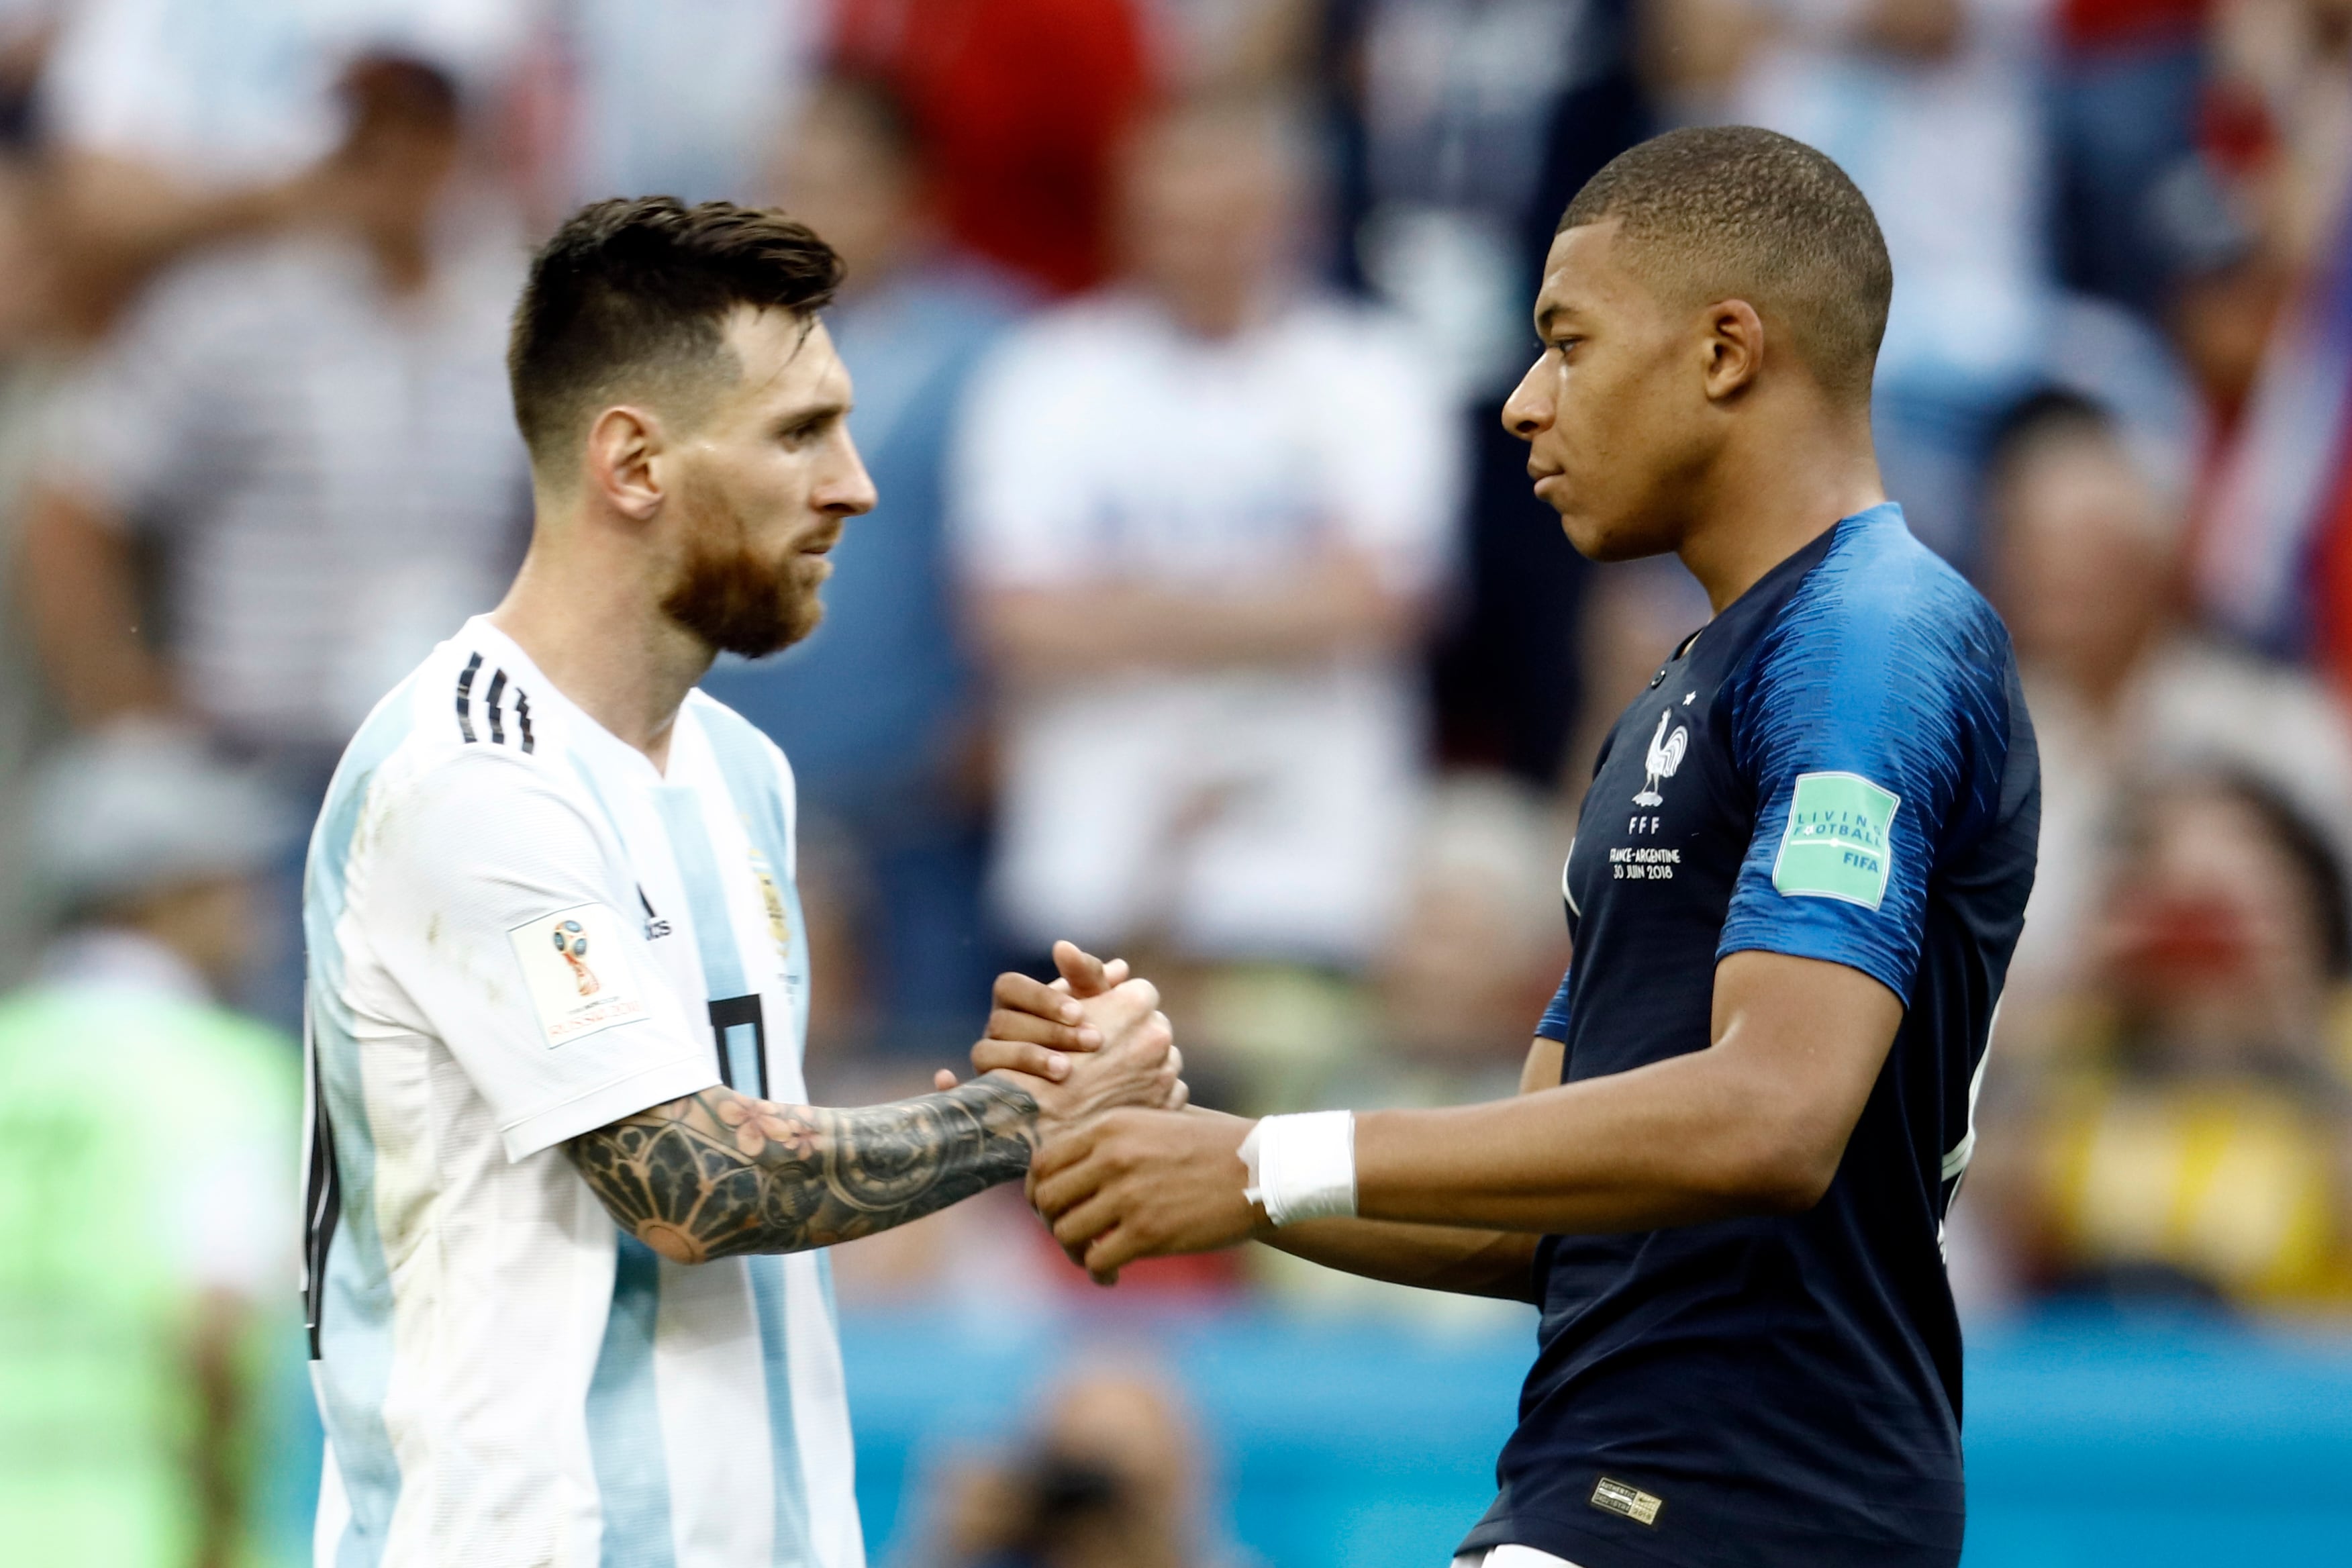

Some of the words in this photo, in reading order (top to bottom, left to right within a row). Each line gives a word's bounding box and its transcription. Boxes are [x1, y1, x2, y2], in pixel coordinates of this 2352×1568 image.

[1609, 847, 1681, 864] FRANCE-ARGENTINE
[1843, 852, 1879, 873] FIFA
[1613, 864, 1624, 879] 30
[1626, 864, 1645, 879] JUIN
[1647, 865, 1673, 880] 2018
